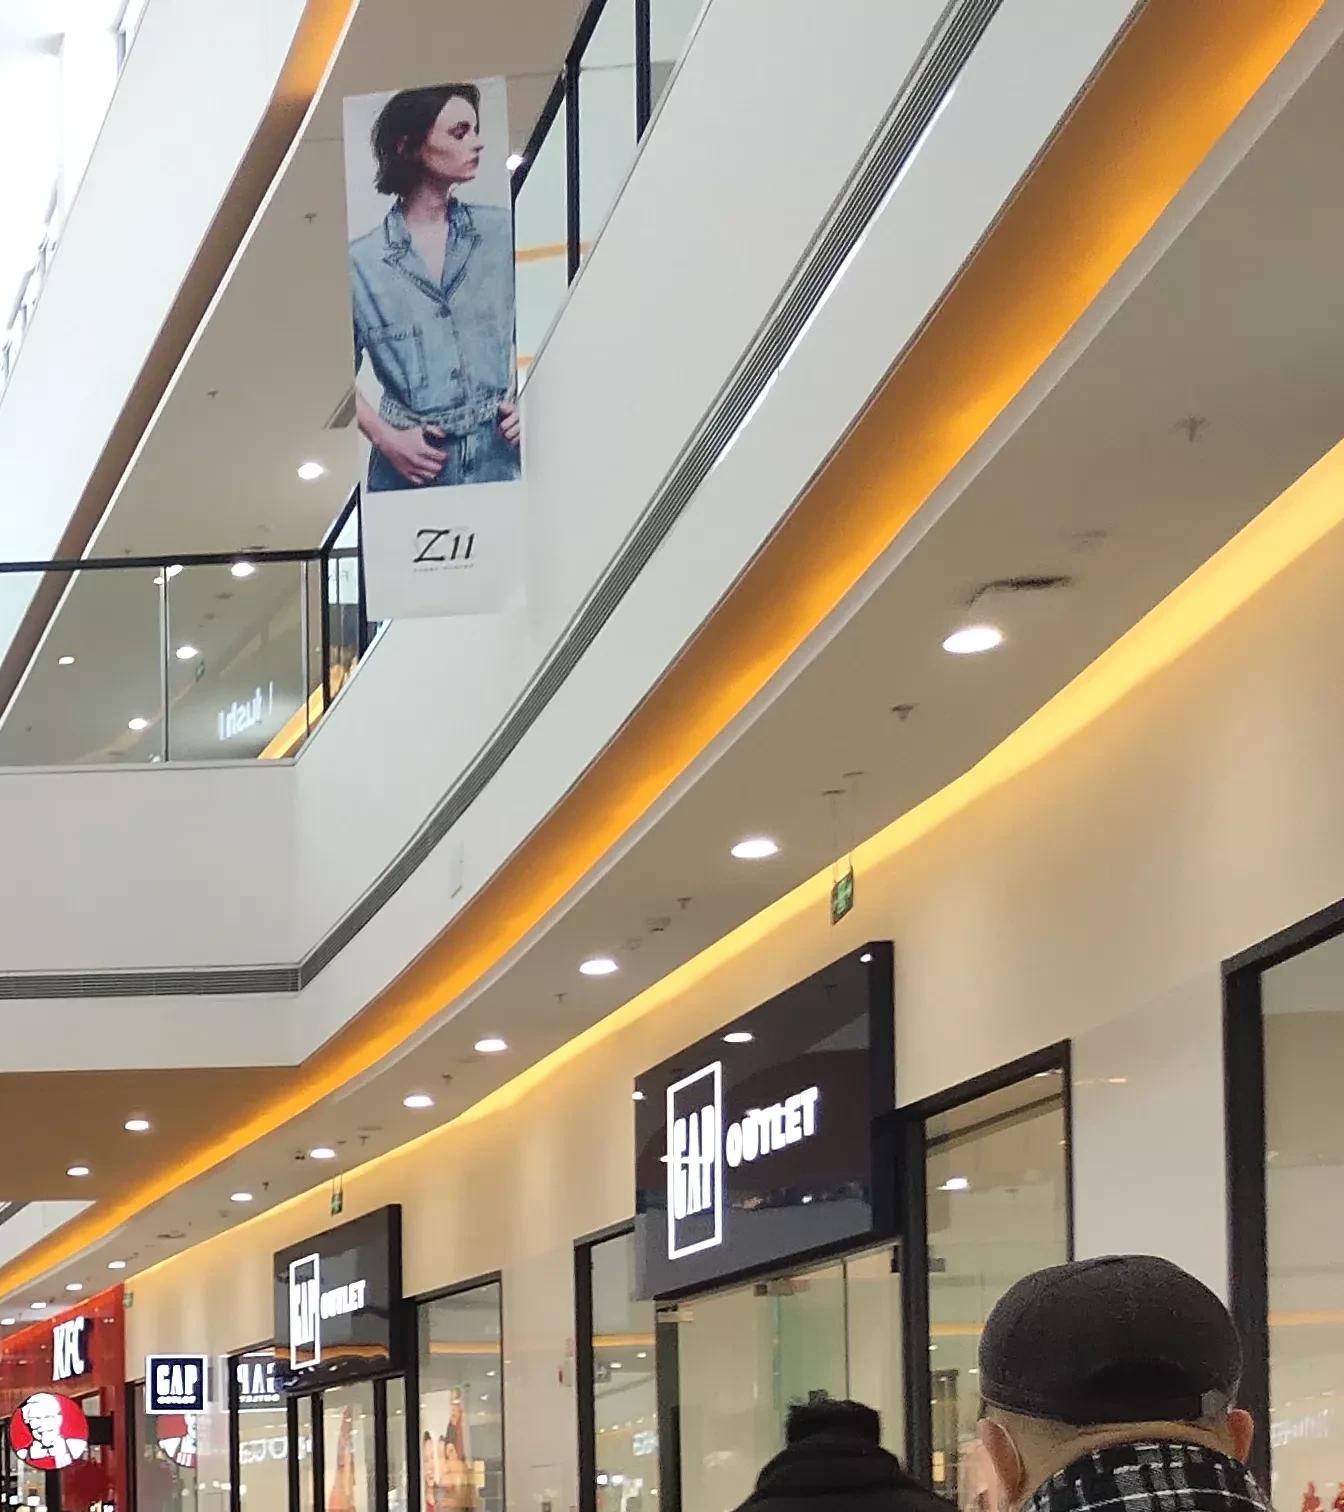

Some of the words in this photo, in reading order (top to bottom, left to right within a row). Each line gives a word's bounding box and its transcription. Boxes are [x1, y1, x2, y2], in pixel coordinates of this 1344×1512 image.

[725, 1086, 819, 1168] OUTLET
[320, 1279, 367, 1320] OUTLET
[52, 1315, 86, 1382] KFC
[156, 1364, 198, 1396] GAP
